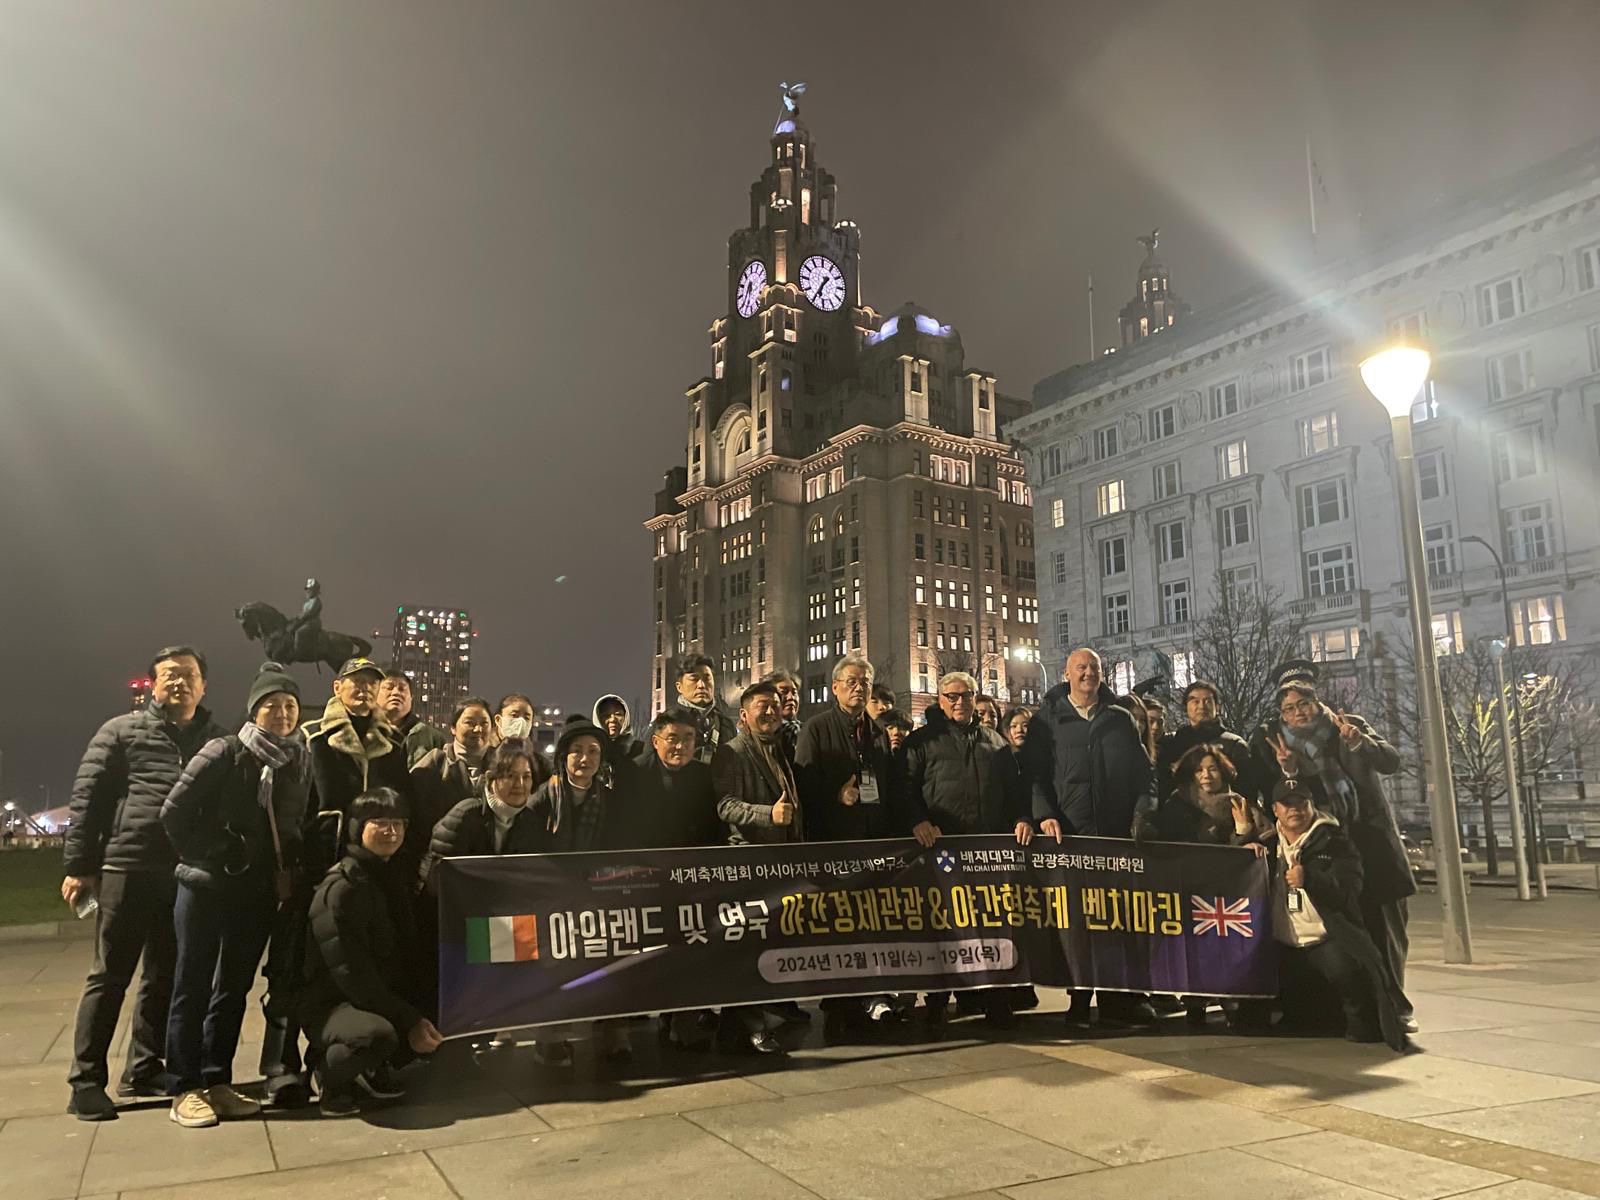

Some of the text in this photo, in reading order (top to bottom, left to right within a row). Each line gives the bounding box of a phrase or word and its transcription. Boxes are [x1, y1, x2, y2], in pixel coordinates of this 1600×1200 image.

[960, 849, 1026, 864] 배재대학교
[1031, 853, 1145, 873] 관광축제한류대학원
[669, 865, 752, 884] 세계축제협회
[755, 862, 821, 880] 아시아지부
[962, 864, 974, 872] PAI
[974, 864, 990, 872] CHAI
[549, 906, 668, 960] 아일랜드
[678, 903, 709, 945] 및
[718, 900, 769, 942] 영국
[1081, 887, 1184, 936] 벤치마킹
[777, 955, 832, 974] 2024년
[835, 953, 868, 970] 12월
[872, 952, 923, 968] 11일(수)
[940, 945, 1001, 965] 19일(목)
